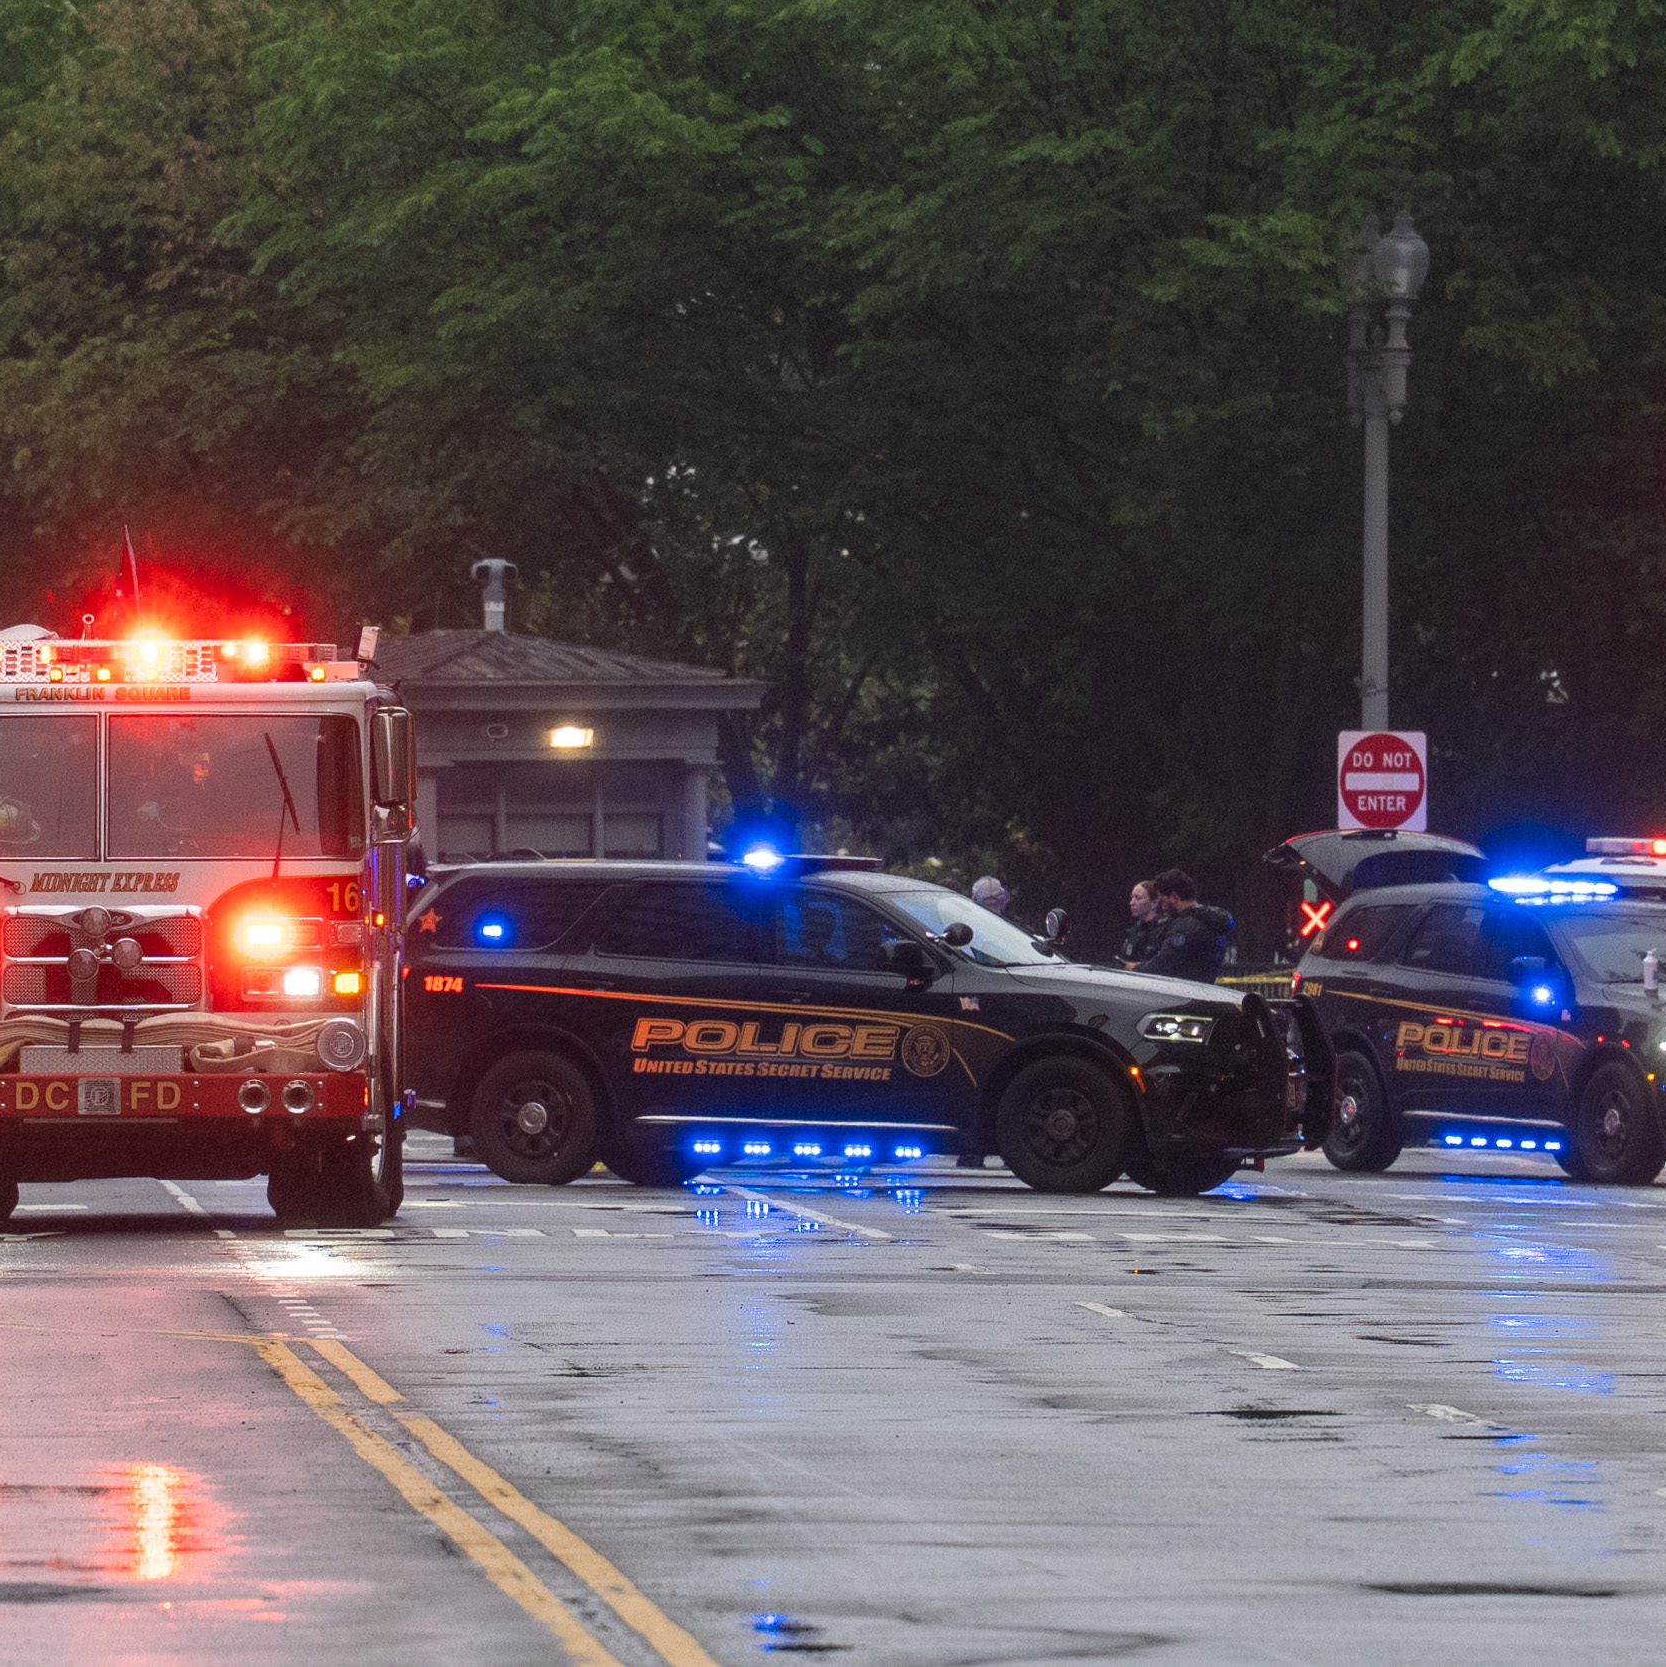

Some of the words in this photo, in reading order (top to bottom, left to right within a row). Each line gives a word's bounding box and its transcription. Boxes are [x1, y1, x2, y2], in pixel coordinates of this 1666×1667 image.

[15, 687, 105, 701] FRANKLIN
[115, 687, 191, 701] SQUARE
[1353, 752, 1373, 768] DO
[1383, 753, 1412, 768] NOT
[1358, 795, 1406, 812] ENTER
[30, 872, 111, 892] MIDNIGHT
[111, 872, 181, 893] EXPRESS
[327, 882, 359, 912] 16
[424, 975, 464, 993] 1874
[631, 1017, 900, 1060] POLICE
[1395, 1021, 1533, 1065] POLICE
[15, 1081, 70, 1111] DC
[130, 1081, 182, 1111] FD
